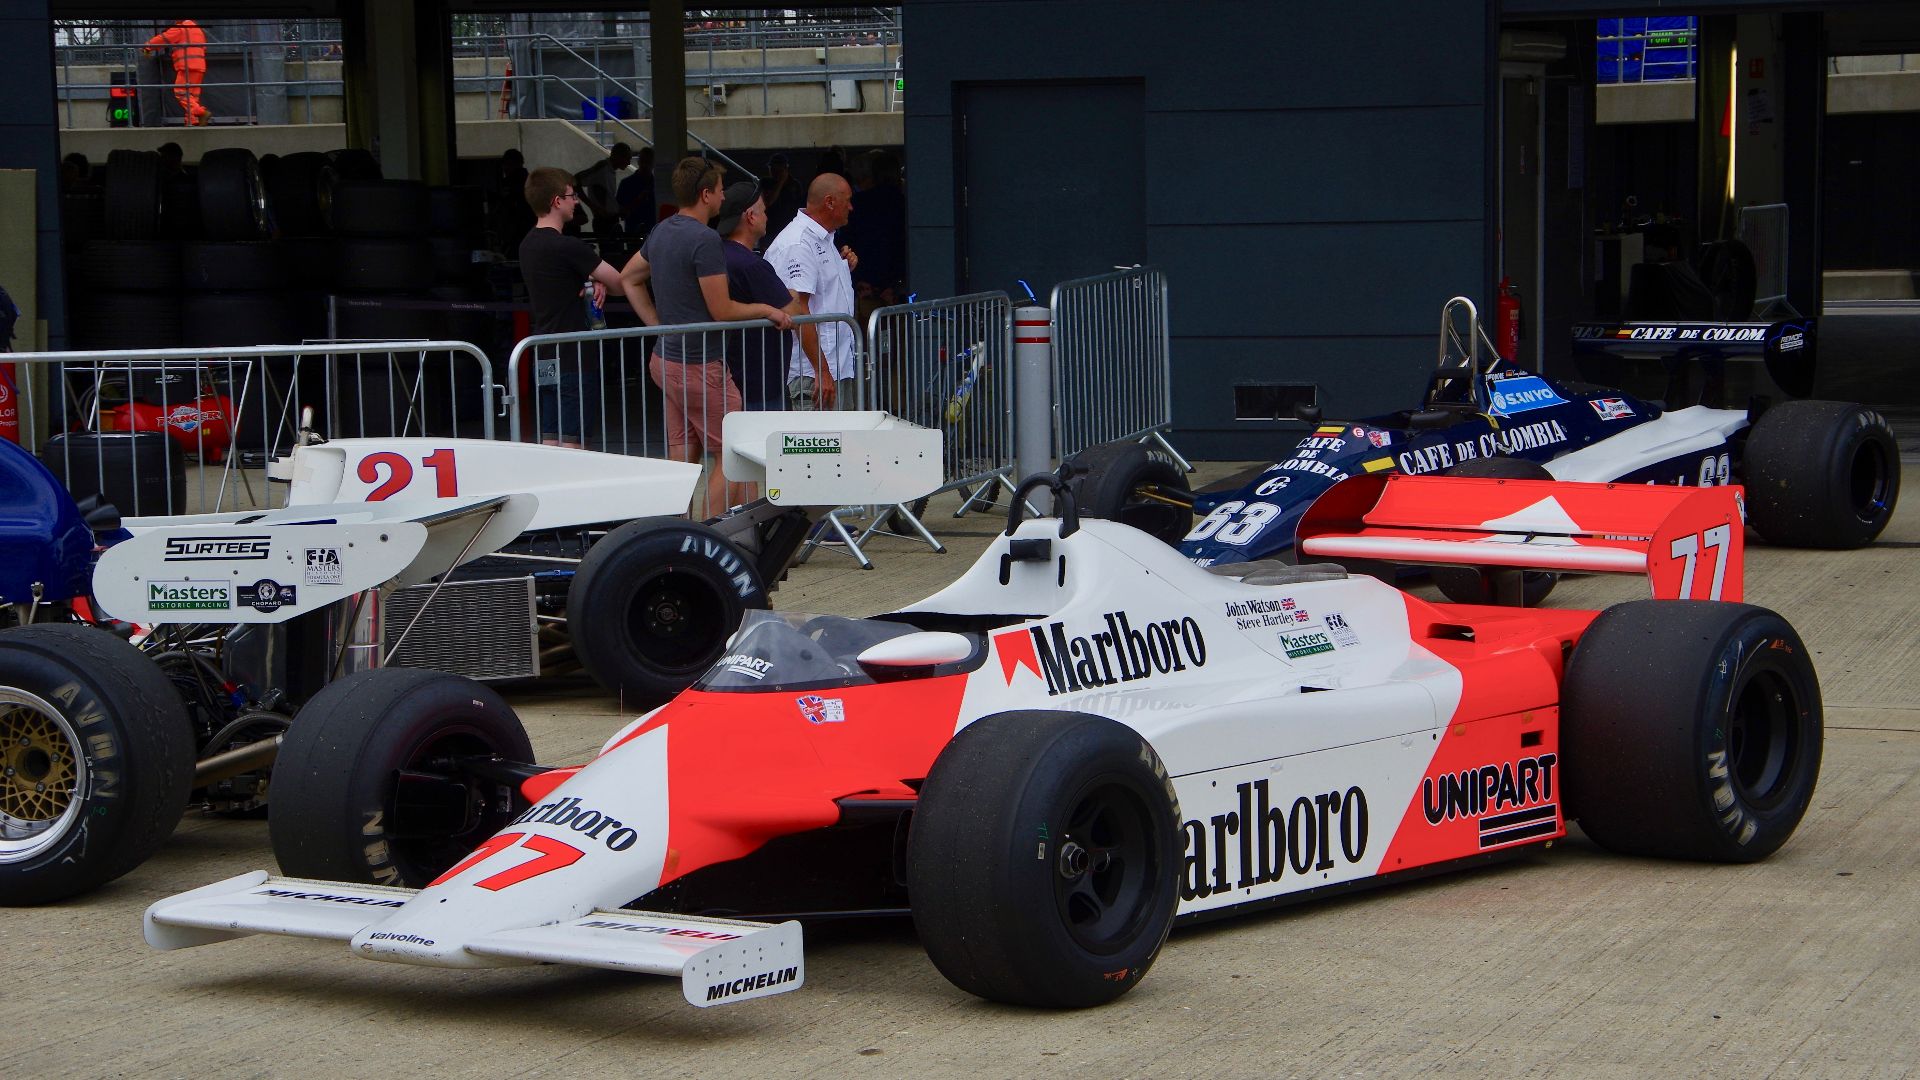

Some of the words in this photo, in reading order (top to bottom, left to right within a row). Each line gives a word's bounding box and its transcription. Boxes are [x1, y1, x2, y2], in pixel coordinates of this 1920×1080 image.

[1630, 327, 1676, 340] CAFE
[1678, 329, 1700, 339] DE
[1702, 328, 1765, 341] COLOM
[1504, 388, 1554, 405] SANYO
[0, 409, 15, 417] LOR
[784, 435, 840, 447] Masters
[1296, 437, 1347, 452] CAFE
[1297, 450, 1320, 458] DE
[1264, 459, 1350, 482] LOMBIA
[1400, 443, 1453, 475] CAFE
[1456, 441, 1477, 461] DE
[357, 449, 458, 502] 21
[1182, 500, 1282, 546] 63
[164, 536, 271, 561] SURTEES
[1670, 523, 1731, 600] 77
[679, 535, 756, 598] AVON
[151, 584, 228, 600] Masters
[1225, 601, 1249, 617] John
[1246, 599, 1281, 614] Watson
[1237, 617, 1261, 630] Steve
[1261, 612, 1294, 626] Hartley
[1030, 611, 1206, 696] Marlboro
[1280, 632, 1328, 650] Masters
[717, 654, 774, 673] UNIPART
[50, 682, 119, 798] AVON
[1422, 752, 1557, 826] UNIPART
[512, 797, 638, 852] arlboro
[362, 810, 404, 887] VON
[1181, 779, 1369, 901] arlboro
[425, 832, 586, 892] 77
[706, 966, 798, 1001] MICHELIN
